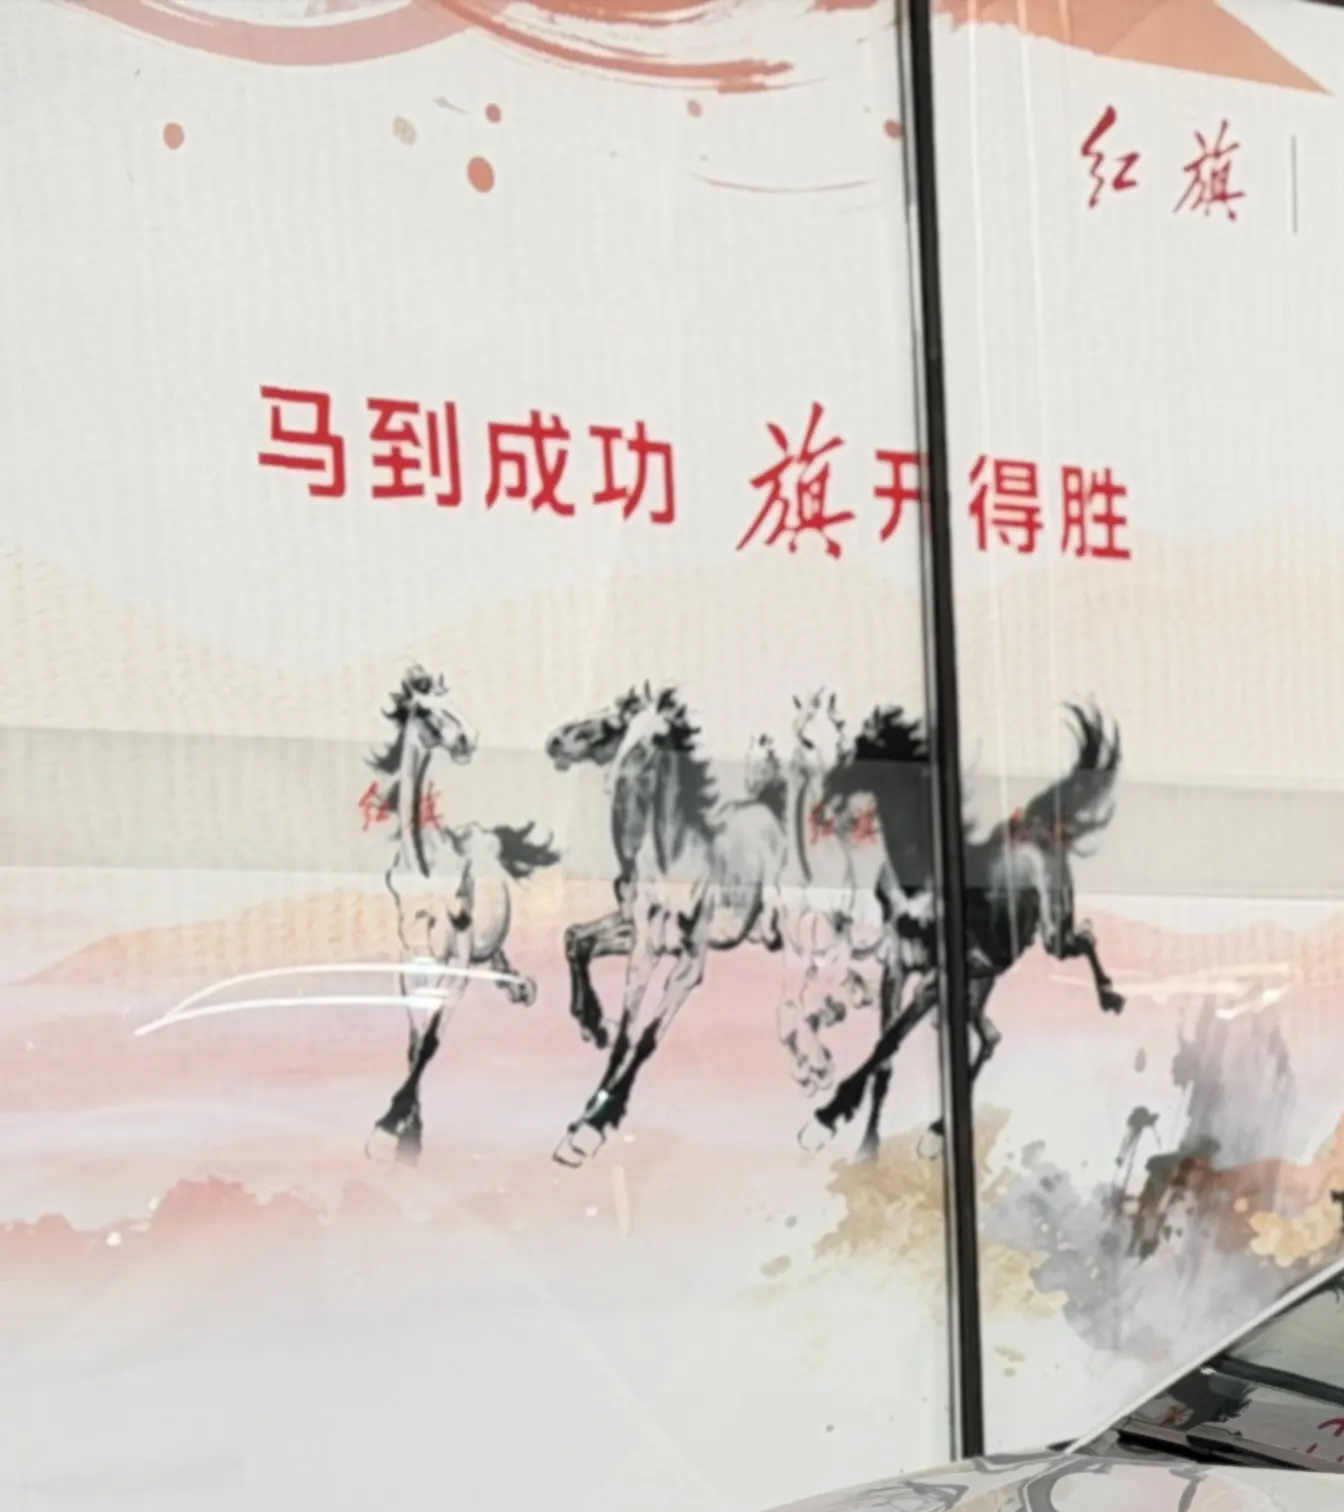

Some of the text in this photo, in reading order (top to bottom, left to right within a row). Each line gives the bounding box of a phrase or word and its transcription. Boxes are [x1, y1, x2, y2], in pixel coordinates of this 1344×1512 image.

[1080, 104, 1246, 223] 红旗
[257, 384, 1132, 560] 马到成功 旗开得胜
